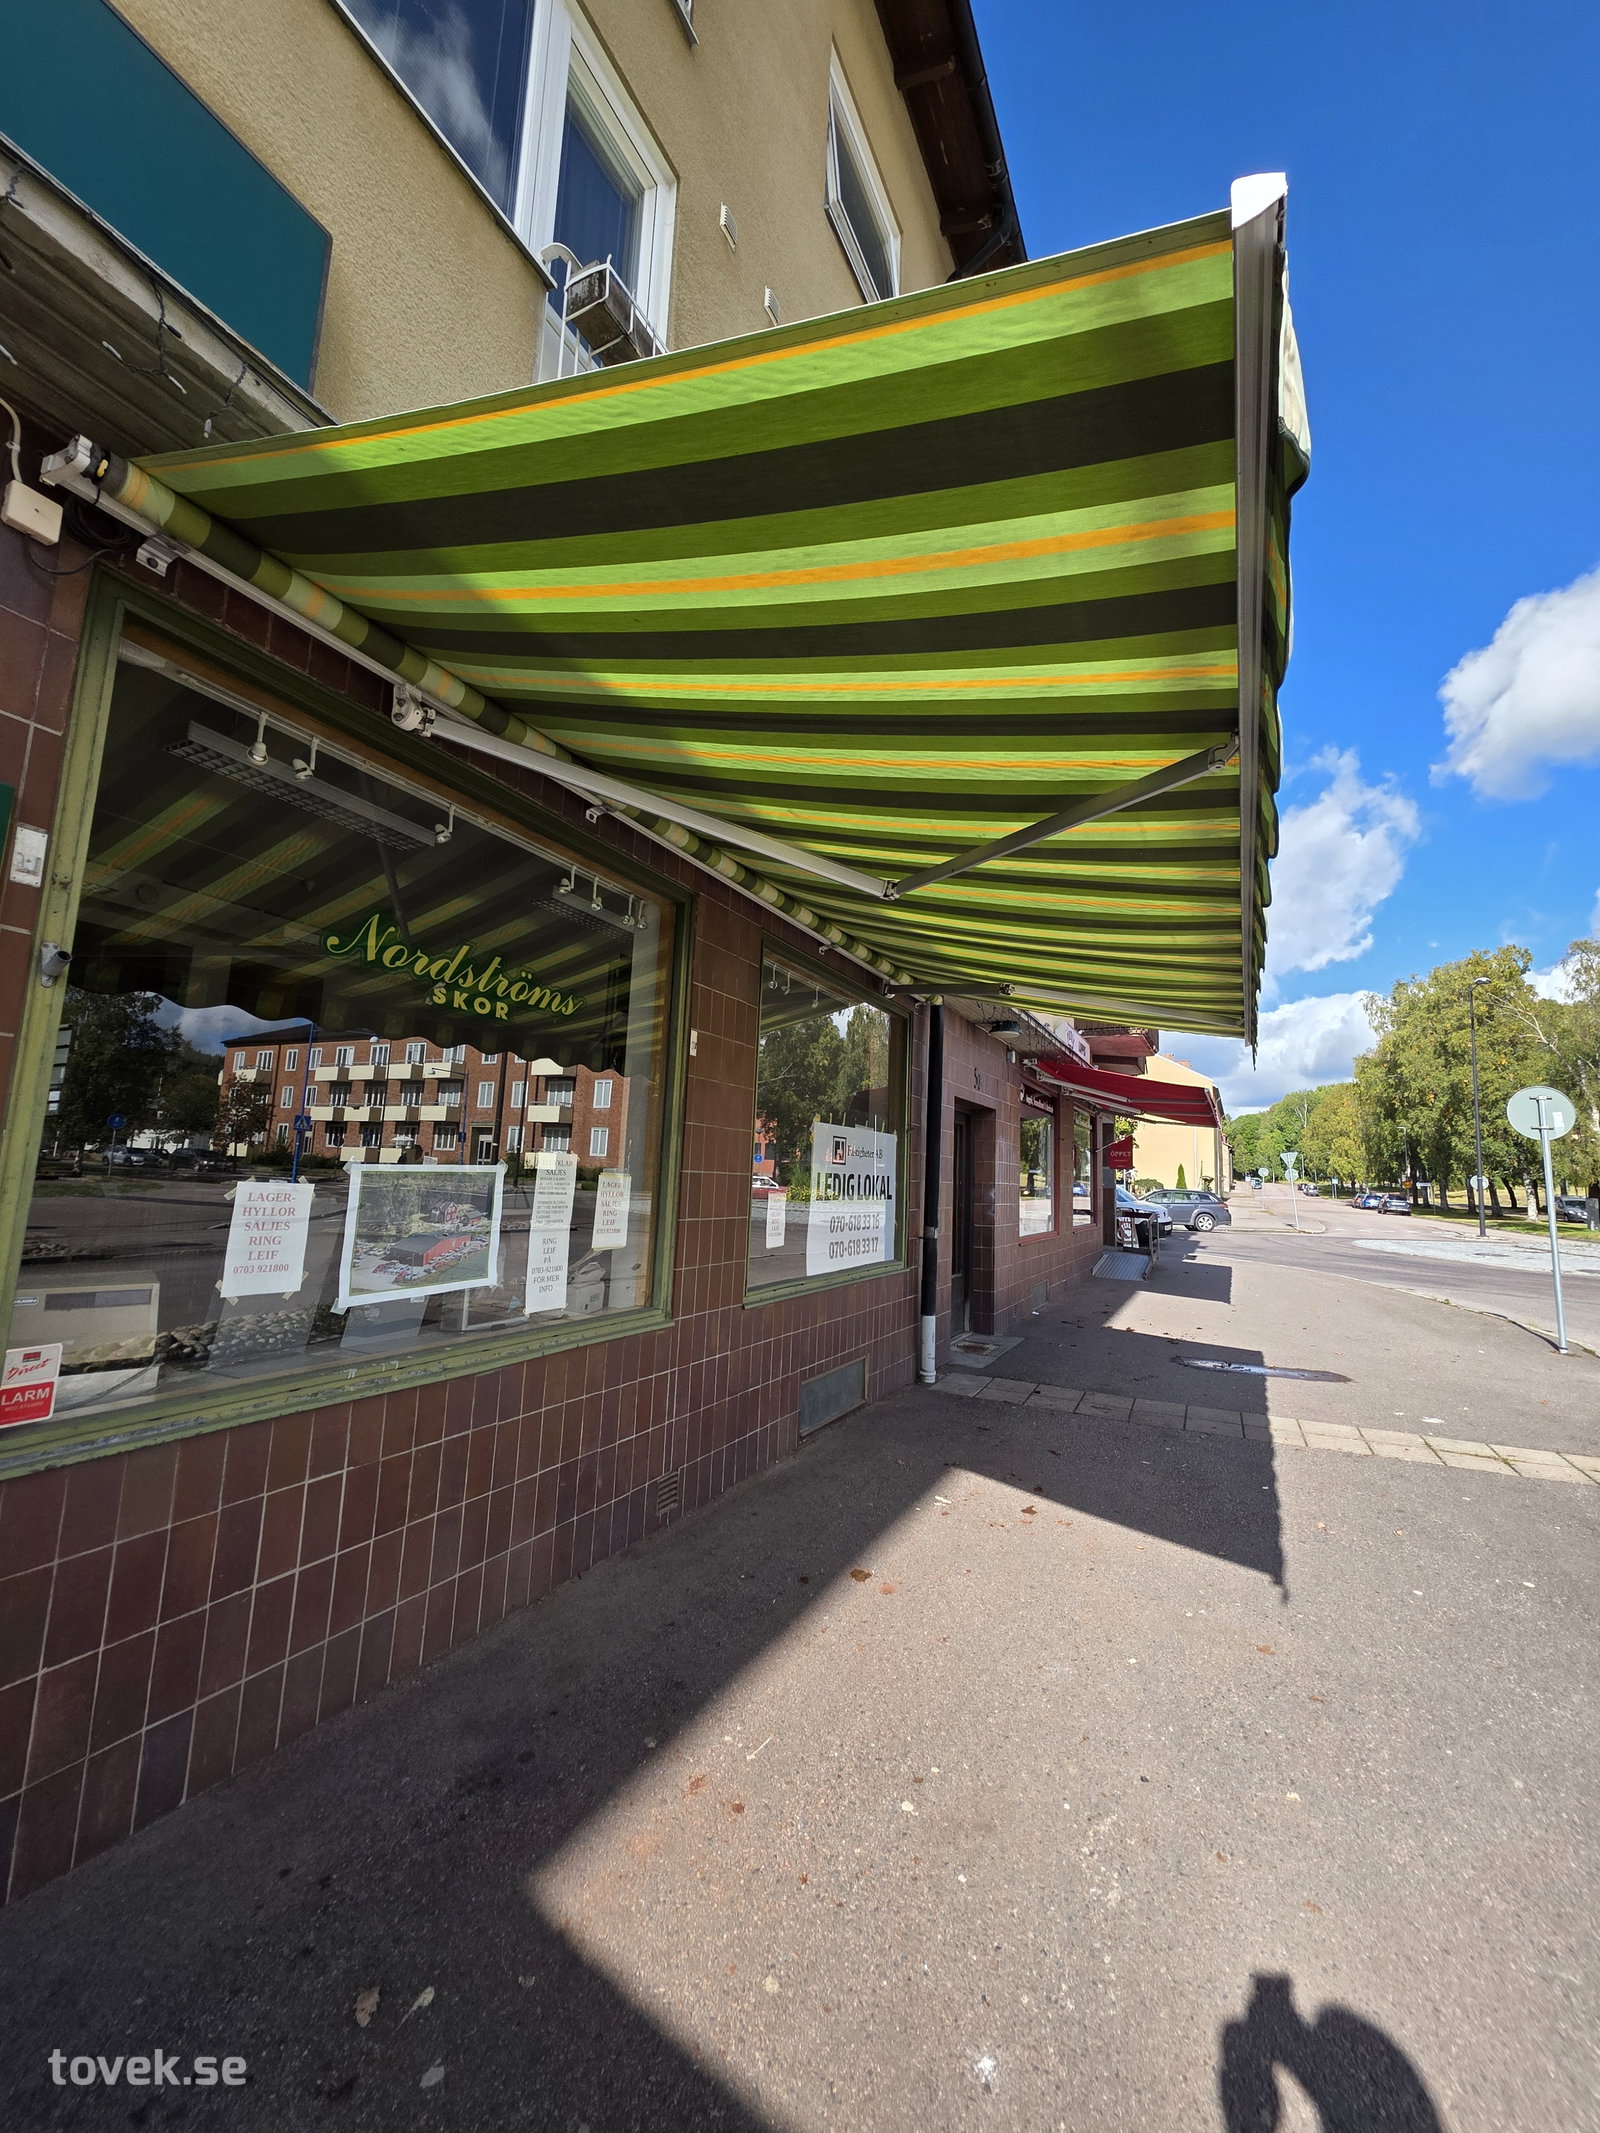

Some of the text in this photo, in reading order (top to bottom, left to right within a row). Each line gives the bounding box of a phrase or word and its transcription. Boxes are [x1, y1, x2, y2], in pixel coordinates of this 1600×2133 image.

[326, 913, 583, 1016] Nordströms
[432, 986, 509, 1020] SKOR
[816, 1172, 892, 1201] LEDIG LOKAL
[247, 1192, 296, 1202] LAGER-
[242, 1207, 296, 1217] HYLLOR
[248, 1235, 282, 1246] RING
[248, 1250, 279, 1261] LEIF
[233, 1264, 289, 1275] 0703 921800
[538, 1285, 554, 1293] INFO
[7, 1357, 55, 1380] Direct
[1, 1387, 50, 1405] LARM
